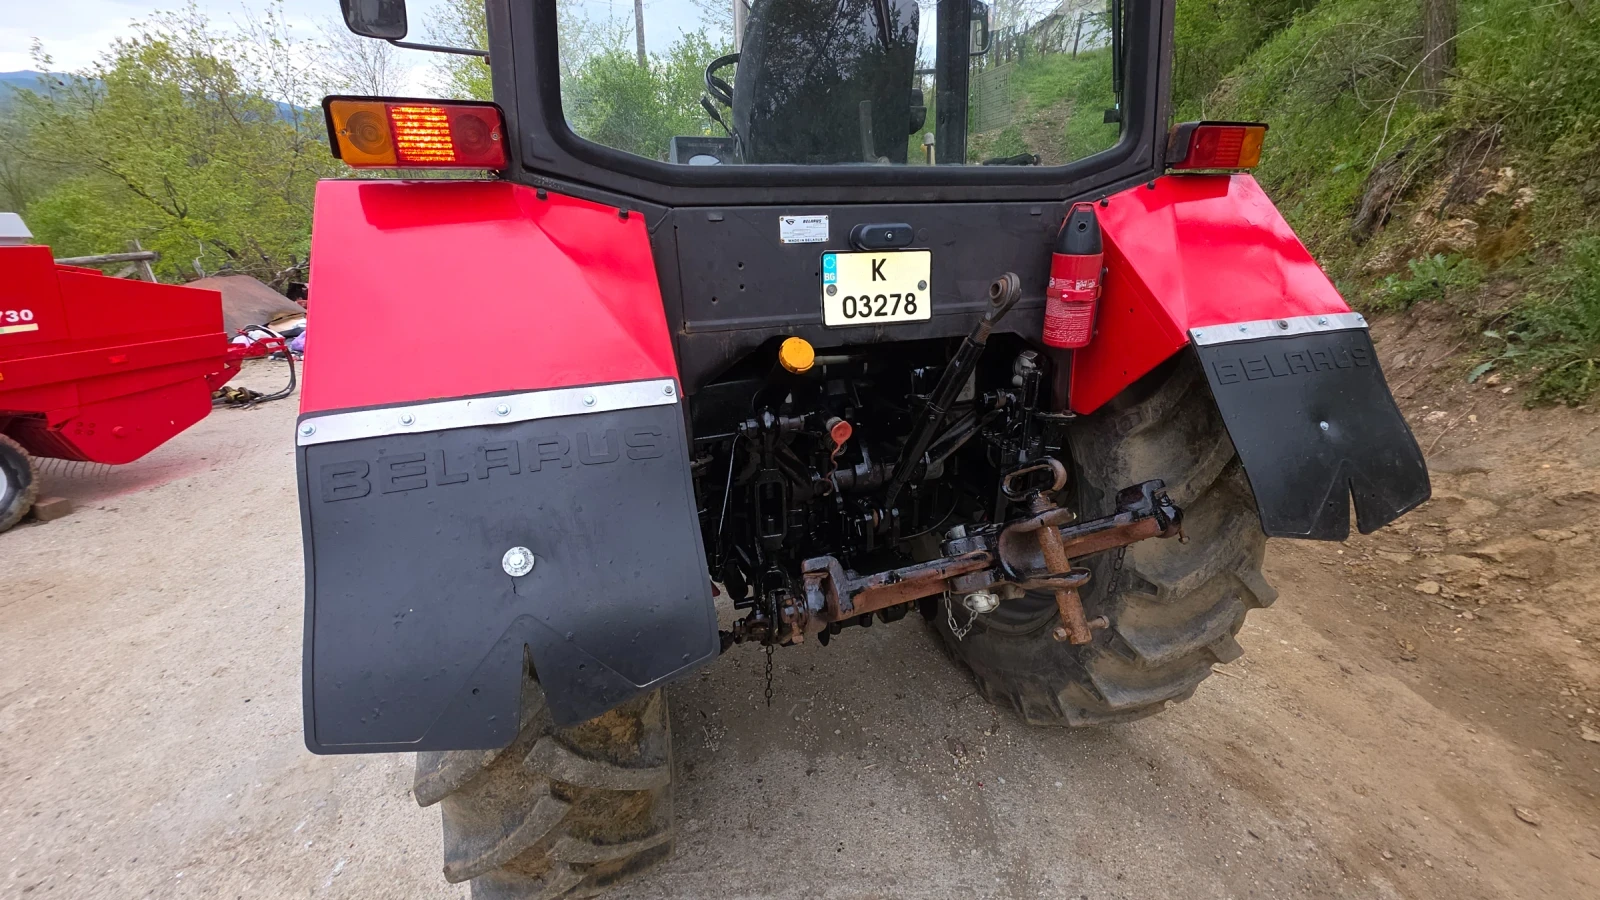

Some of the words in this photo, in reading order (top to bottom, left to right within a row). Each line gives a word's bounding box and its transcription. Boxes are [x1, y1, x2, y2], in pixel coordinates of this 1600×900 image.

[824, 273, 836, 281] BG
[872, 259, 886, 281] K
[0, 309, 34, 322] 30
[842, 293, 917, 318] 03278
[1212, 346, 1370, 385] BELARUS
[319, 426, 664, 503] BELARUS
